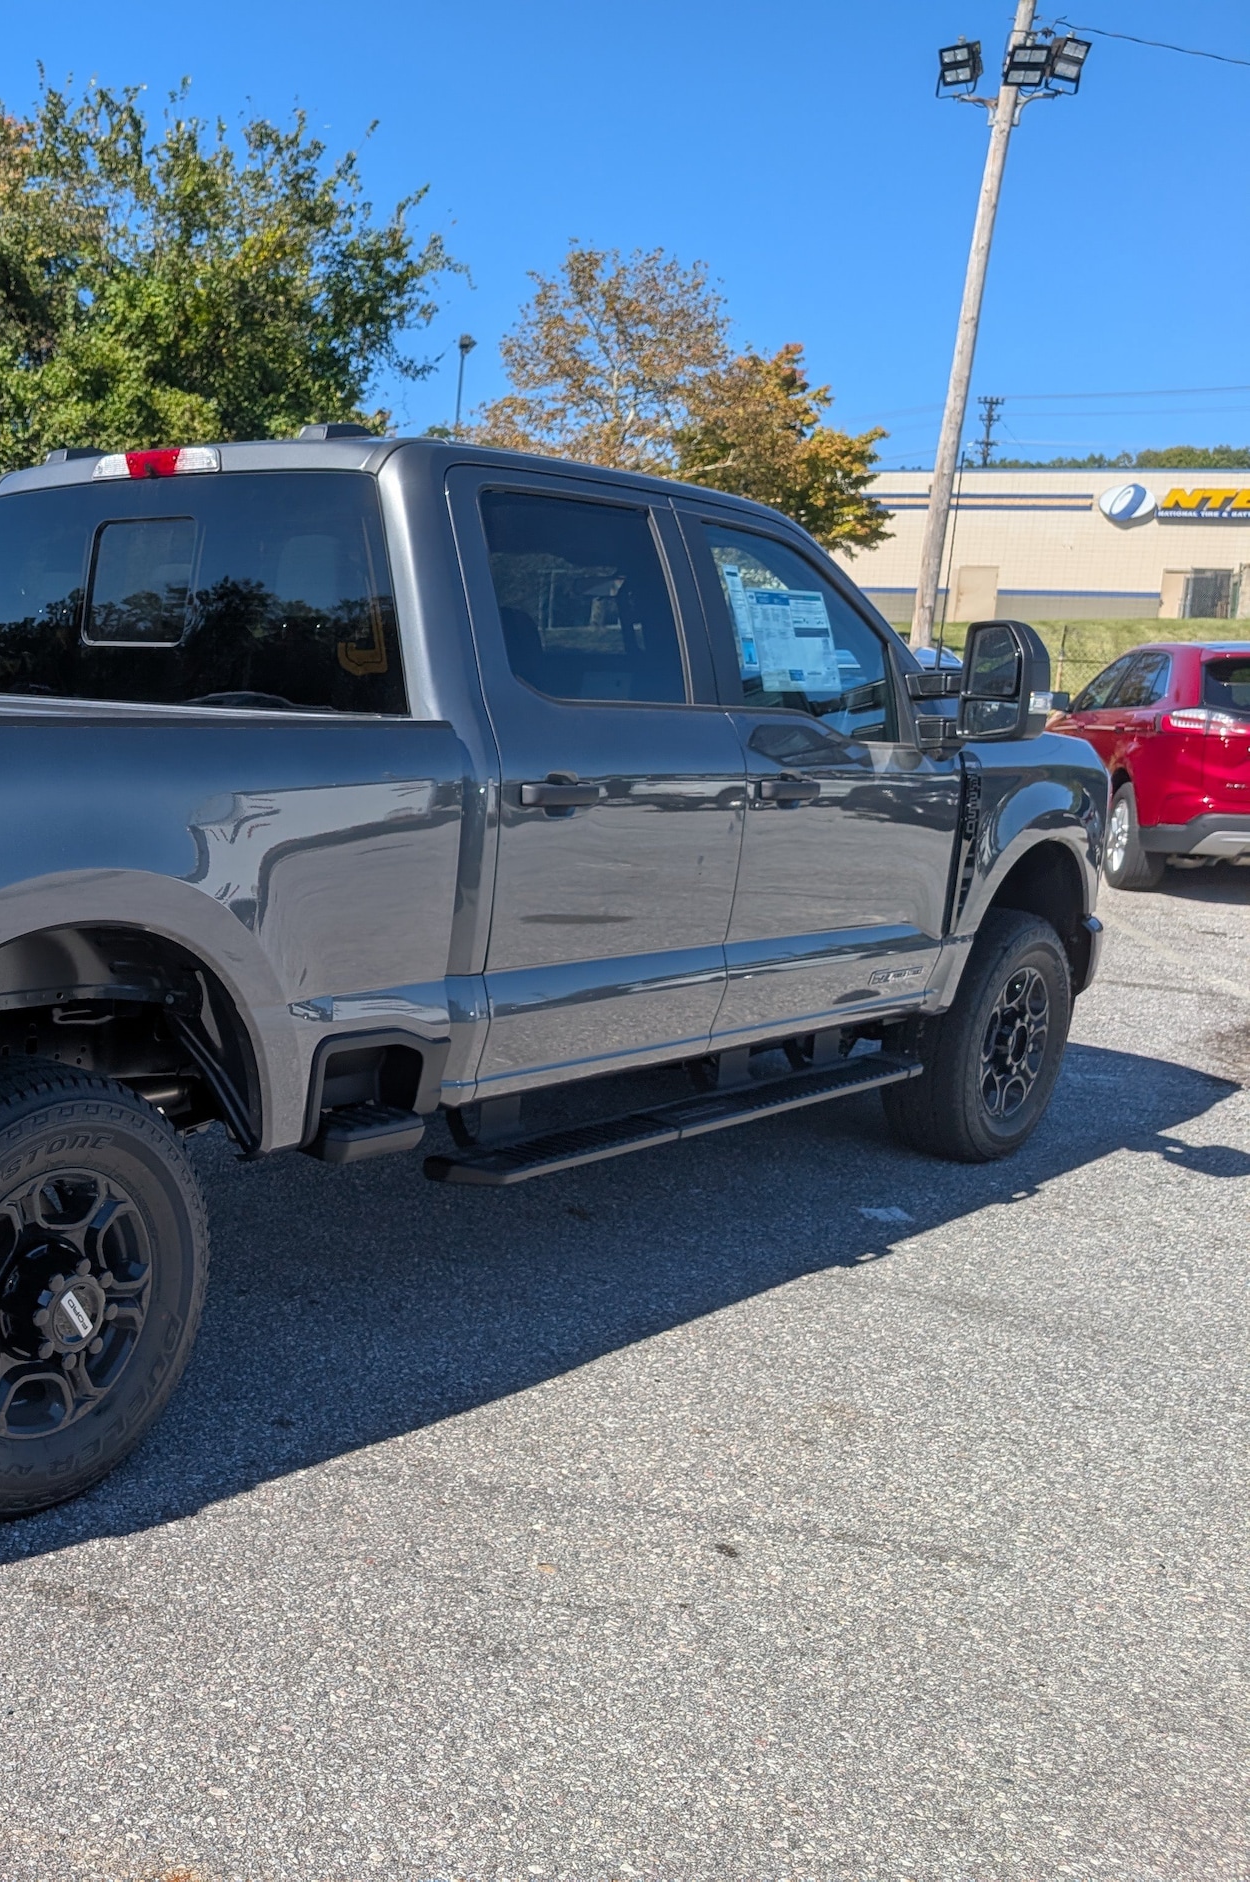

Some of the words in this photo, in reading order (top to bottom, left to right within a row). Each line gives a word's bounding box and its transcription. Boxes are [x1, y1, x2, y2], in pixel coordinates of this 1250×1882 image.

[1157, 510, 1198, 518] NATIONAL
[1200, 510, 1219, 518] TIRE
[67, 1298, 89, 1330] FORD
